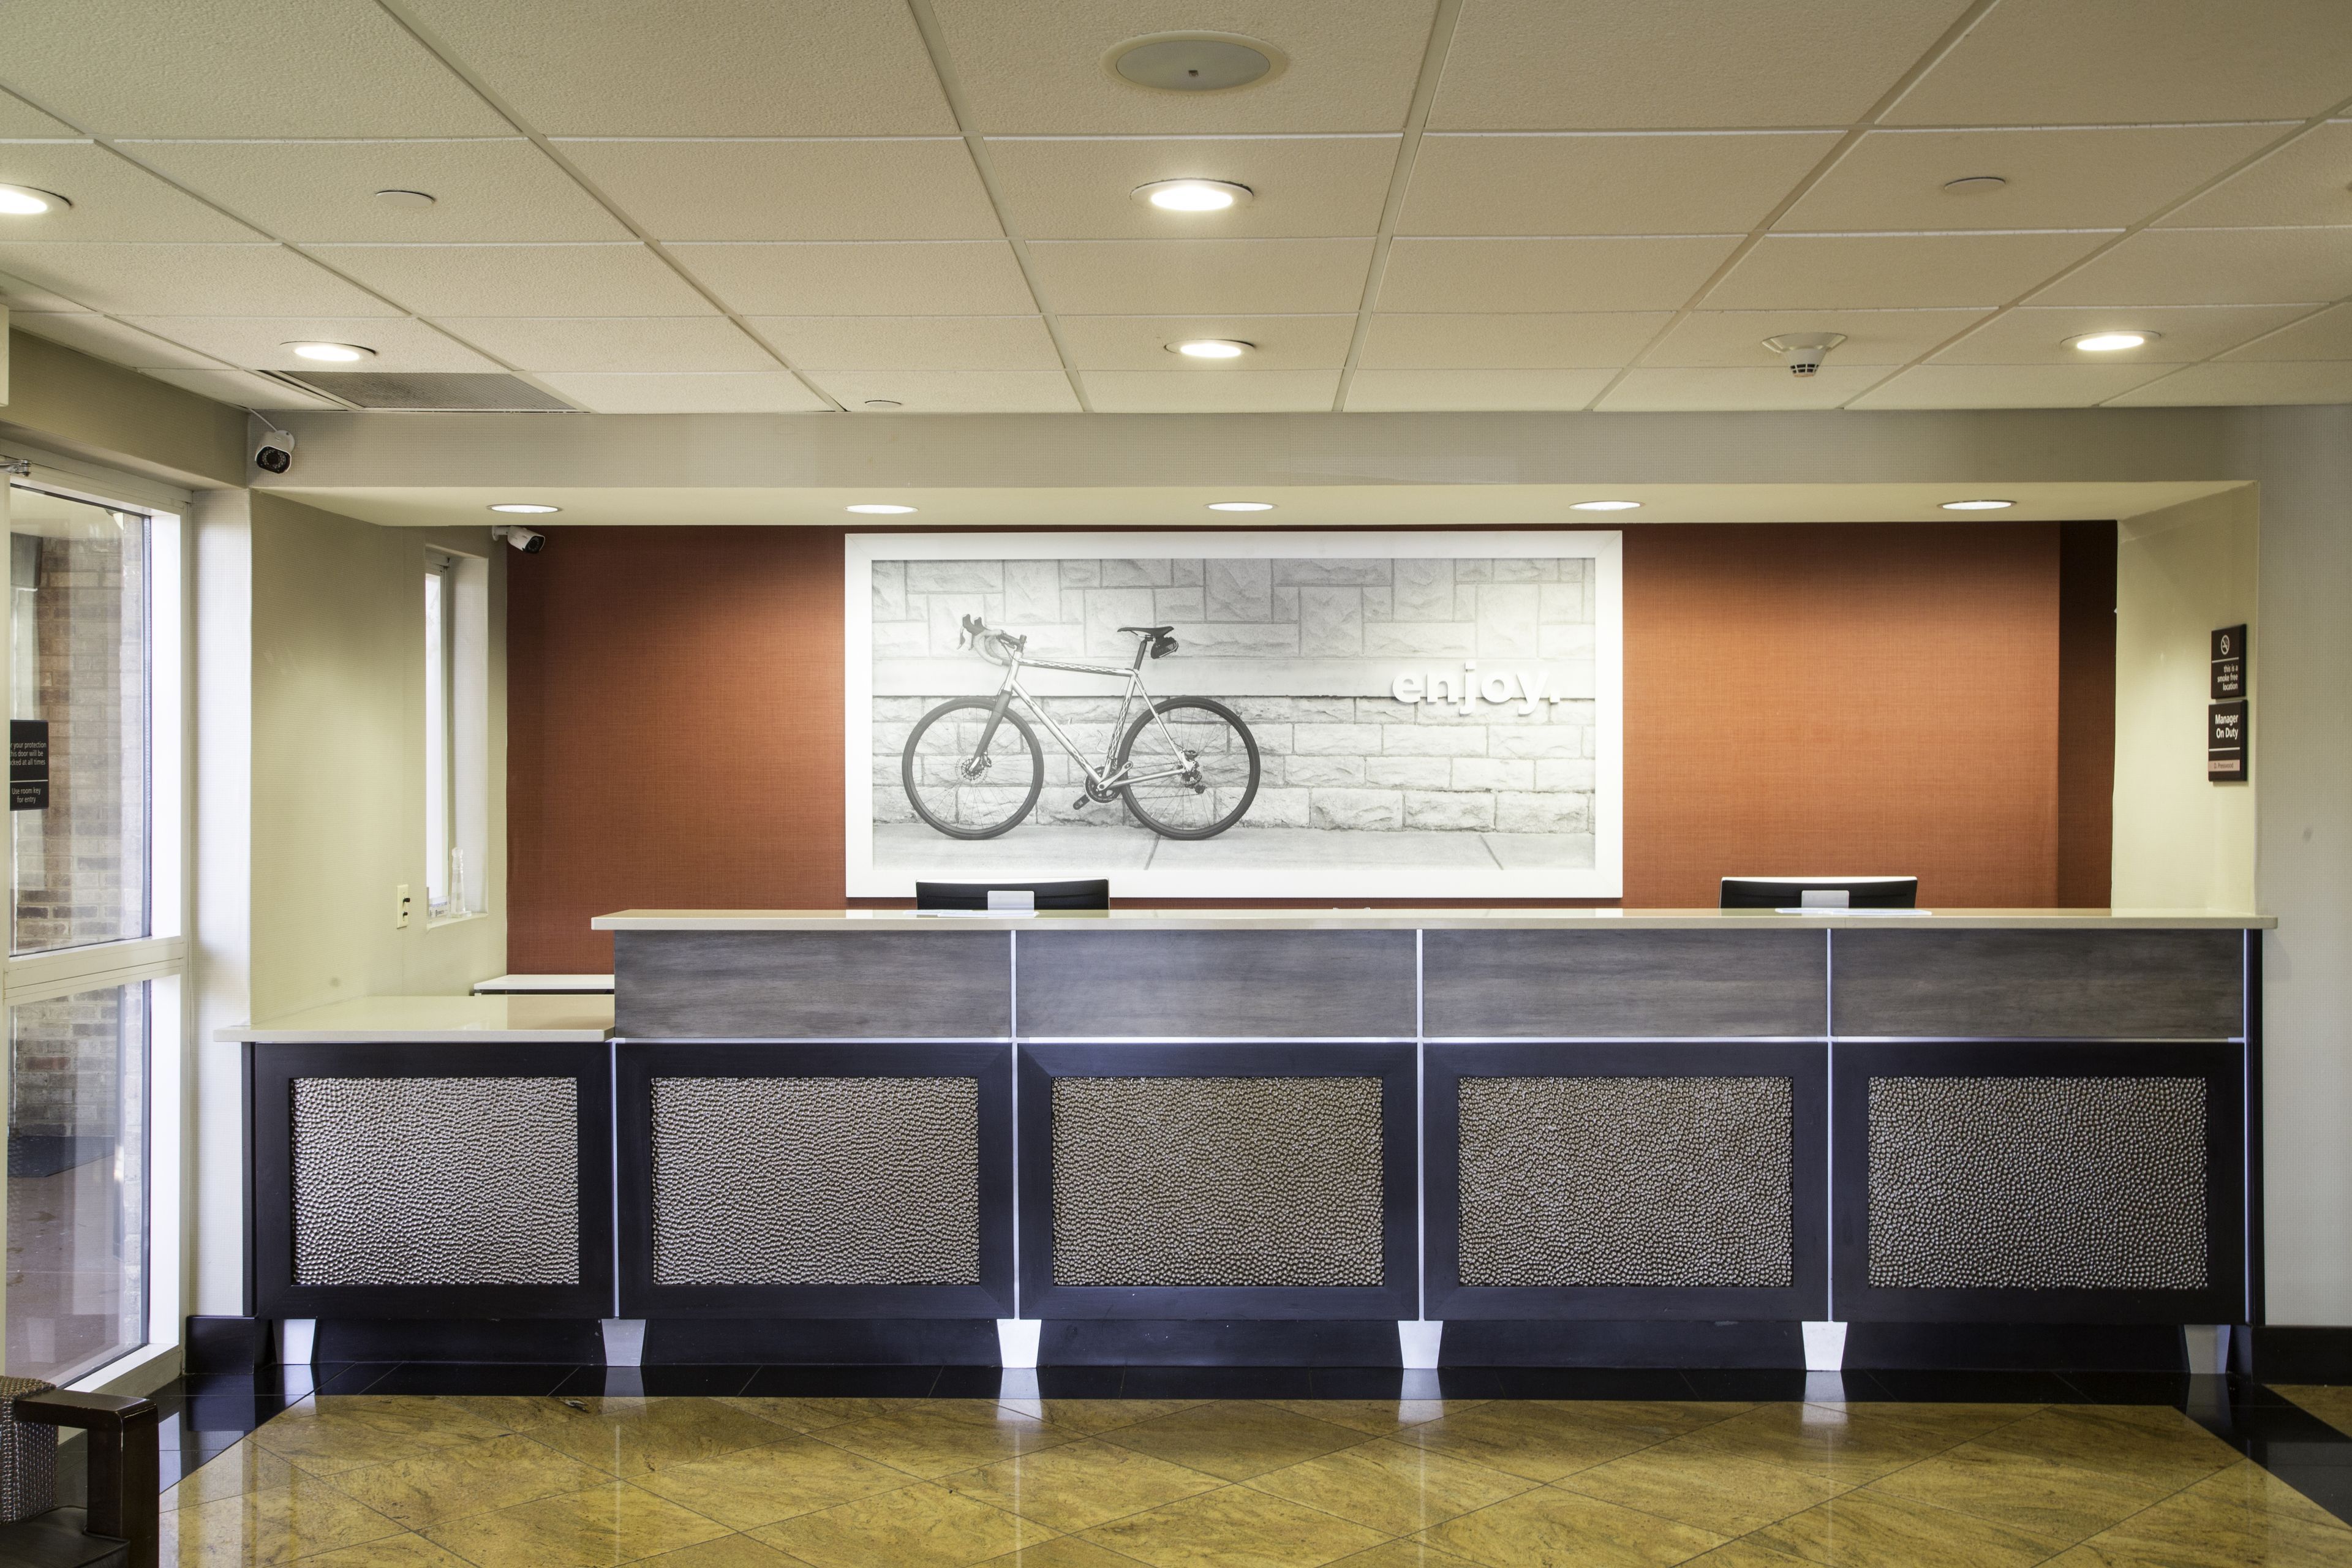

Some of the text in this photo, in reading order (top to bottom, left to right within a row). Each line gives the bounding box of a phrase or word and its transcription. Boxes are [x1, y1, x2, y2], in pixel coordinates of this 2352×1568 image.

[2217, 674, 2230, 683] smoke
[1392, 661, 1561, 715] enjoy.
[2223, 682, 2238, 691] location
[2215, 714, 2239, 726] Manager
[2216, 727, 2239, 740] On Duty
